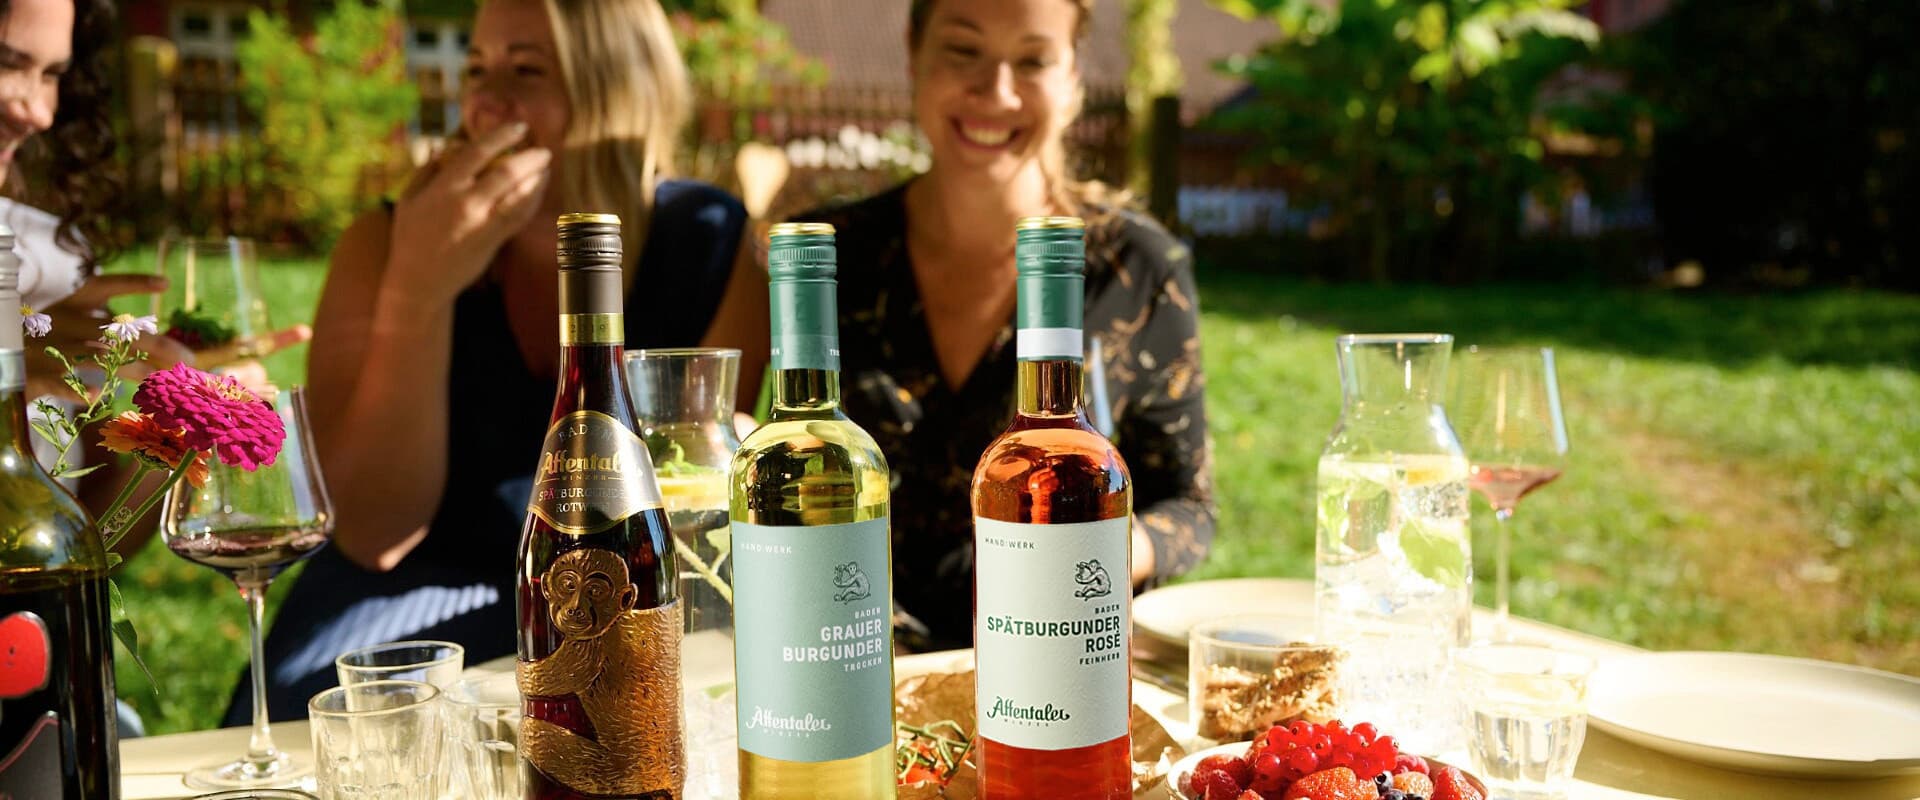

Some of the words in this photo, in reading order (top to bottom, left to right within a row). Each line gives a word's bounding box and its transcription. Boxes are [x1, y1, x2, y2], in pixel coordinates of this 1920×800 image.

[535, 449, 643, 486] Affental
[556, 501, 610, 513] ROTW
[854, 607, 881, 619] BADEN
[1095, 603, 1120, 615] BADEN
[820, 618, 882, 642] GRAUER
[987, 615, 1120, 637] SPÄTBURGUNDER
[783, 637, 883, 662] BURGUNDER
[1085, 629, 1121, 653] ROSÉ
[843, 656, 883, 673] TROCKEN
[1079, 652, 1120, 666] FEINHERB
[745, 705, 831, 732] Affentaler
[987, 695, 1070, 722] Affentaler
